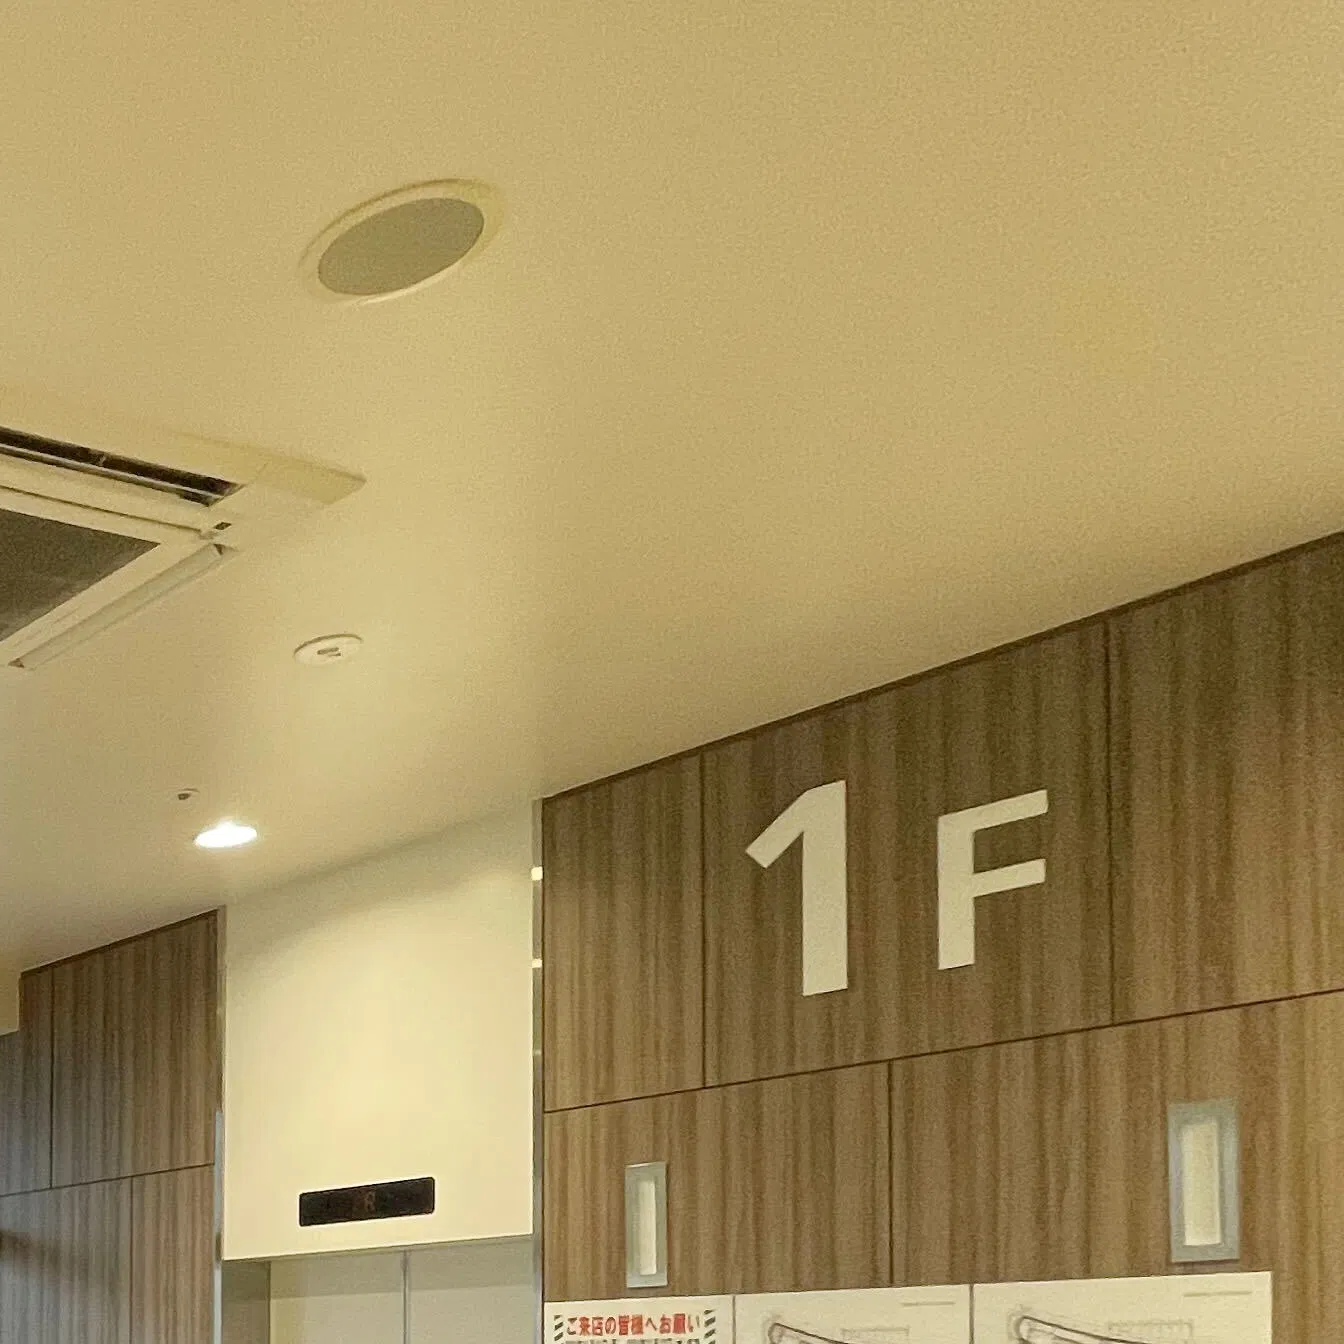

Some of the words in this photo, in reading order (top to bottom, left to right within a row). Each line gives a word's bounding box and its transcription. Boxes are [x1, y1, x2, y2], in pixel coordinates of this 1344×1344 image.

[566, 1313, 700, 1337] ご来店の皆様へお願い
